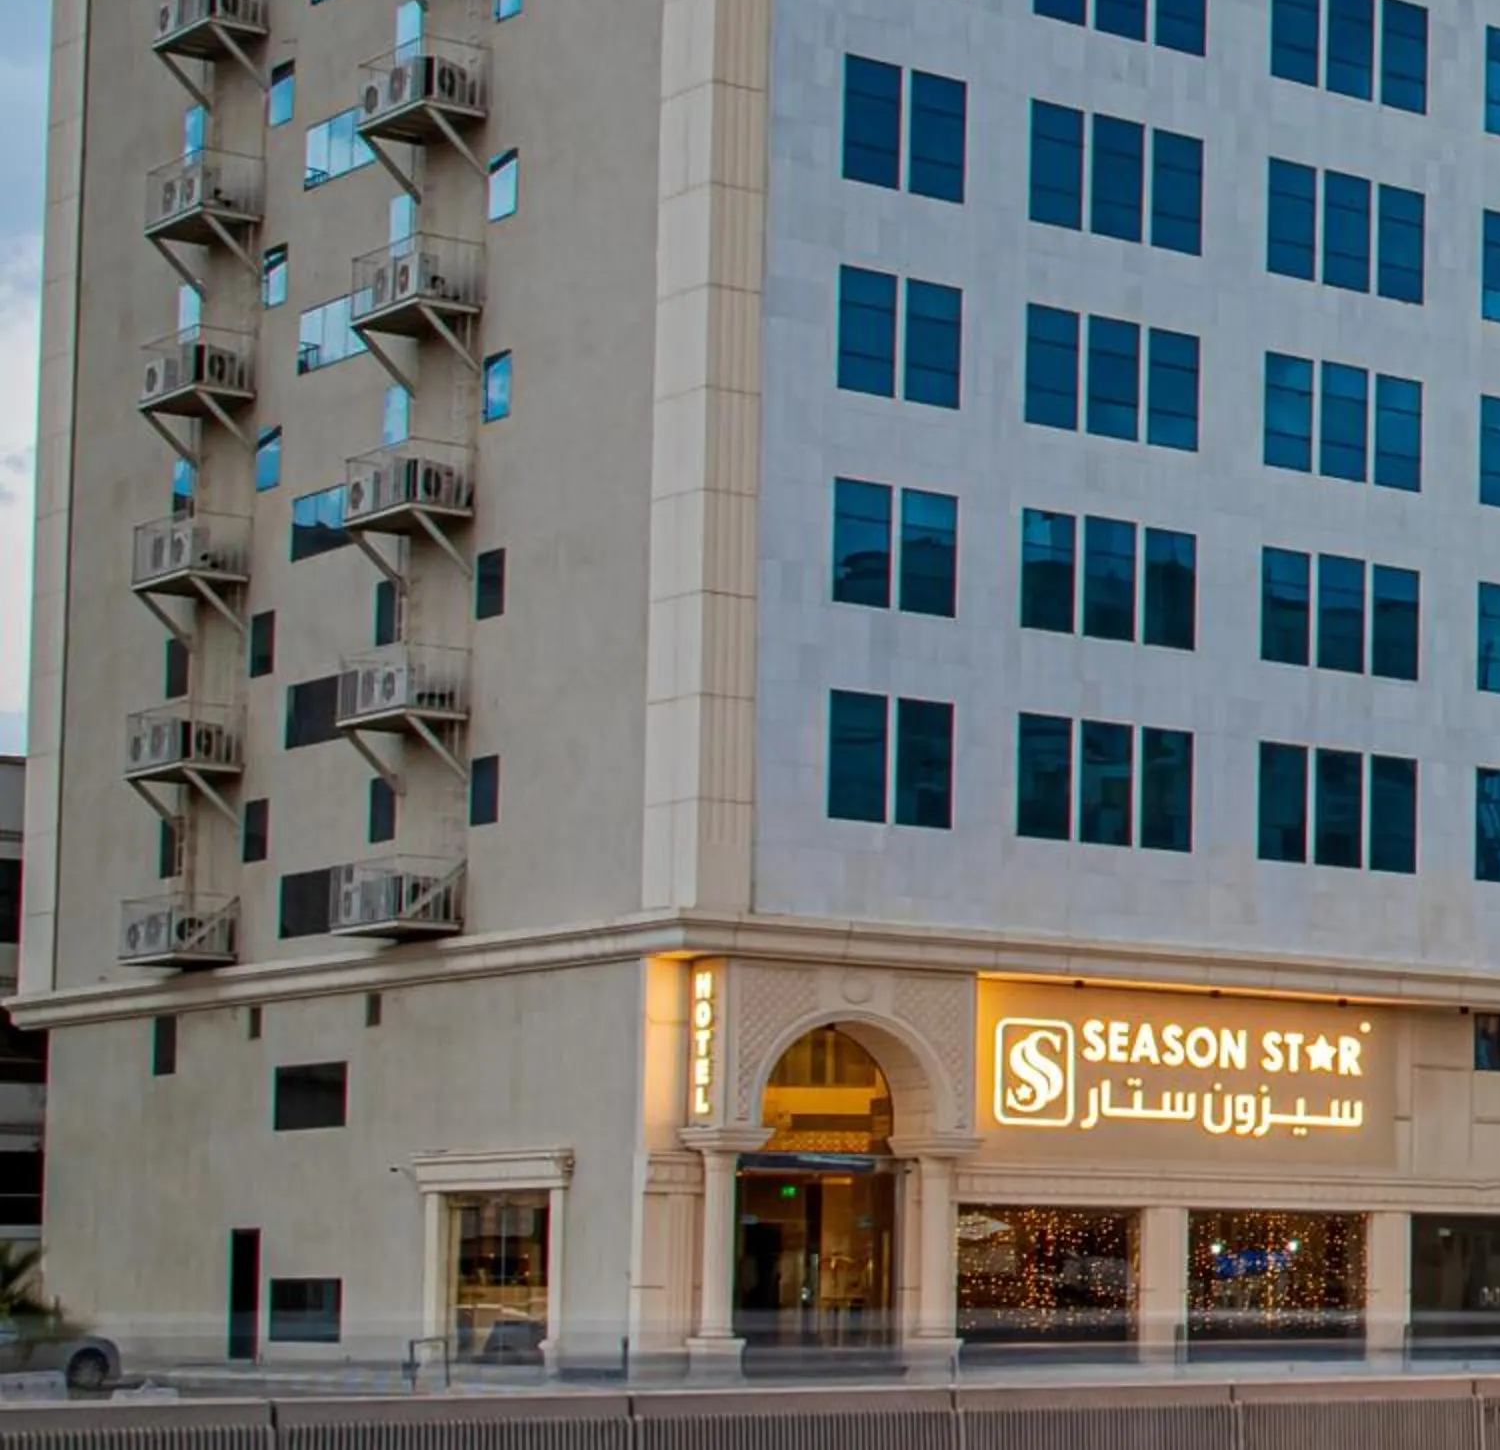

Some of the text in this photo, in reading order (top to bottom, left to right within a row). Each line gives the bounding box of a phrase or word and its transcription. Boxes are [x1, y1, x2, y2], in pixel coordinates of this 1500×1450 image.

[693, 971, 713, 1115] HOTEL
[1081, 1018, 1248, 1071] SEASON
[1079, 1077, 1364, 1138] سيزون ستار
